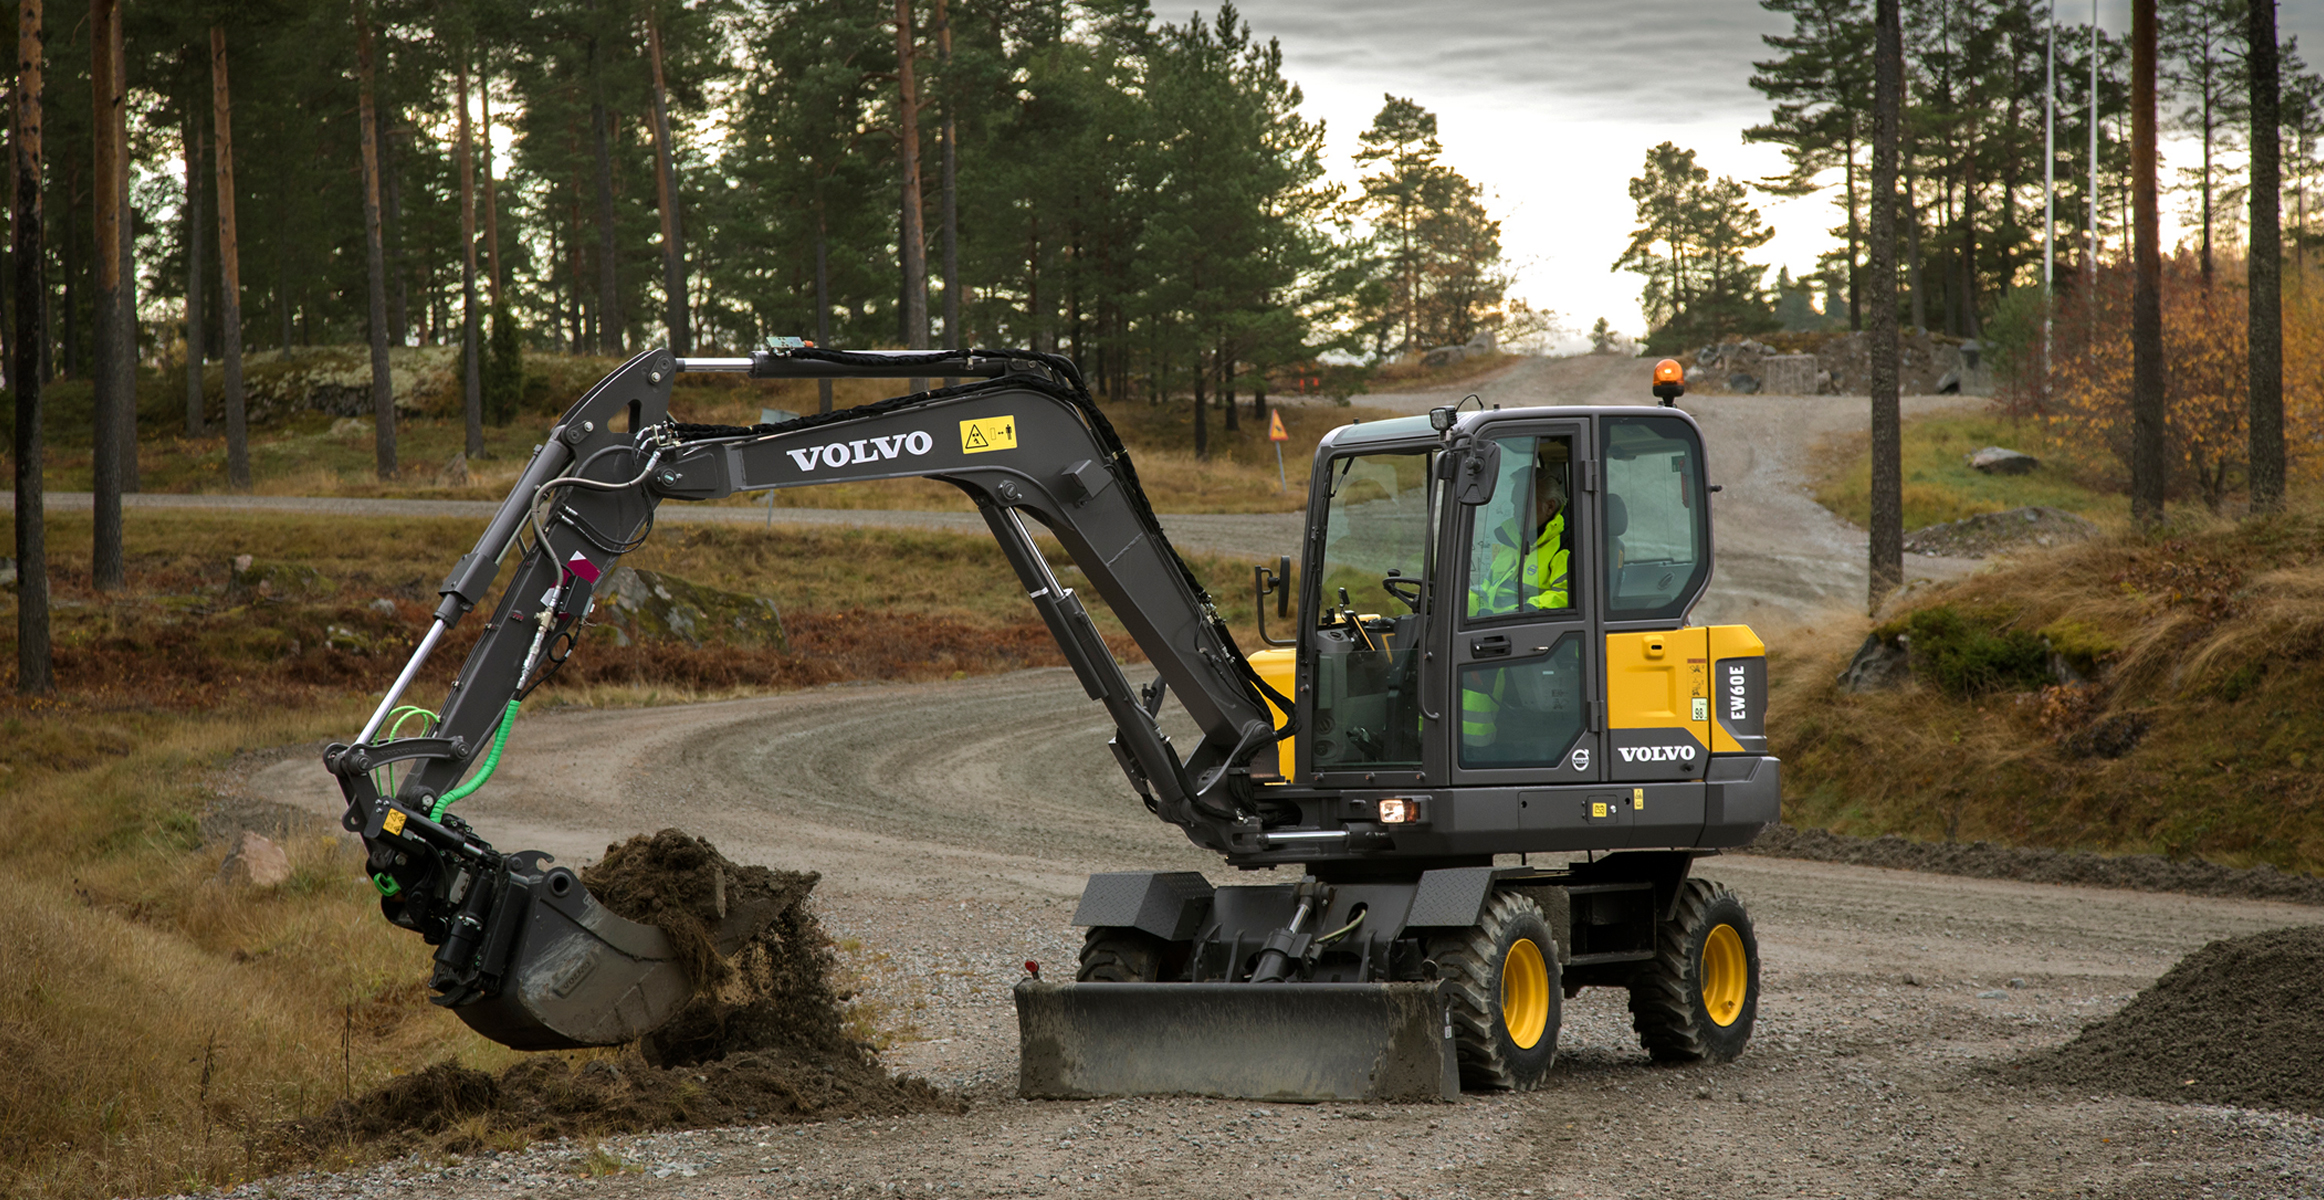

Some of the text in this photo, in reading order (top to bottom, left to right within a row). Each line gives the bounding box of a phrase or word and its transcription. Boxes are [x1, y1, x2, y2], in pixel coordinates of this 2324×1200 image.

[786, 430, 933, 472] VOLVO
[1729, 666, 1746, 720] EW60E
[1695, 707, 1704, 719] 98
[1618, 745, 1696, 763] VOLVO
